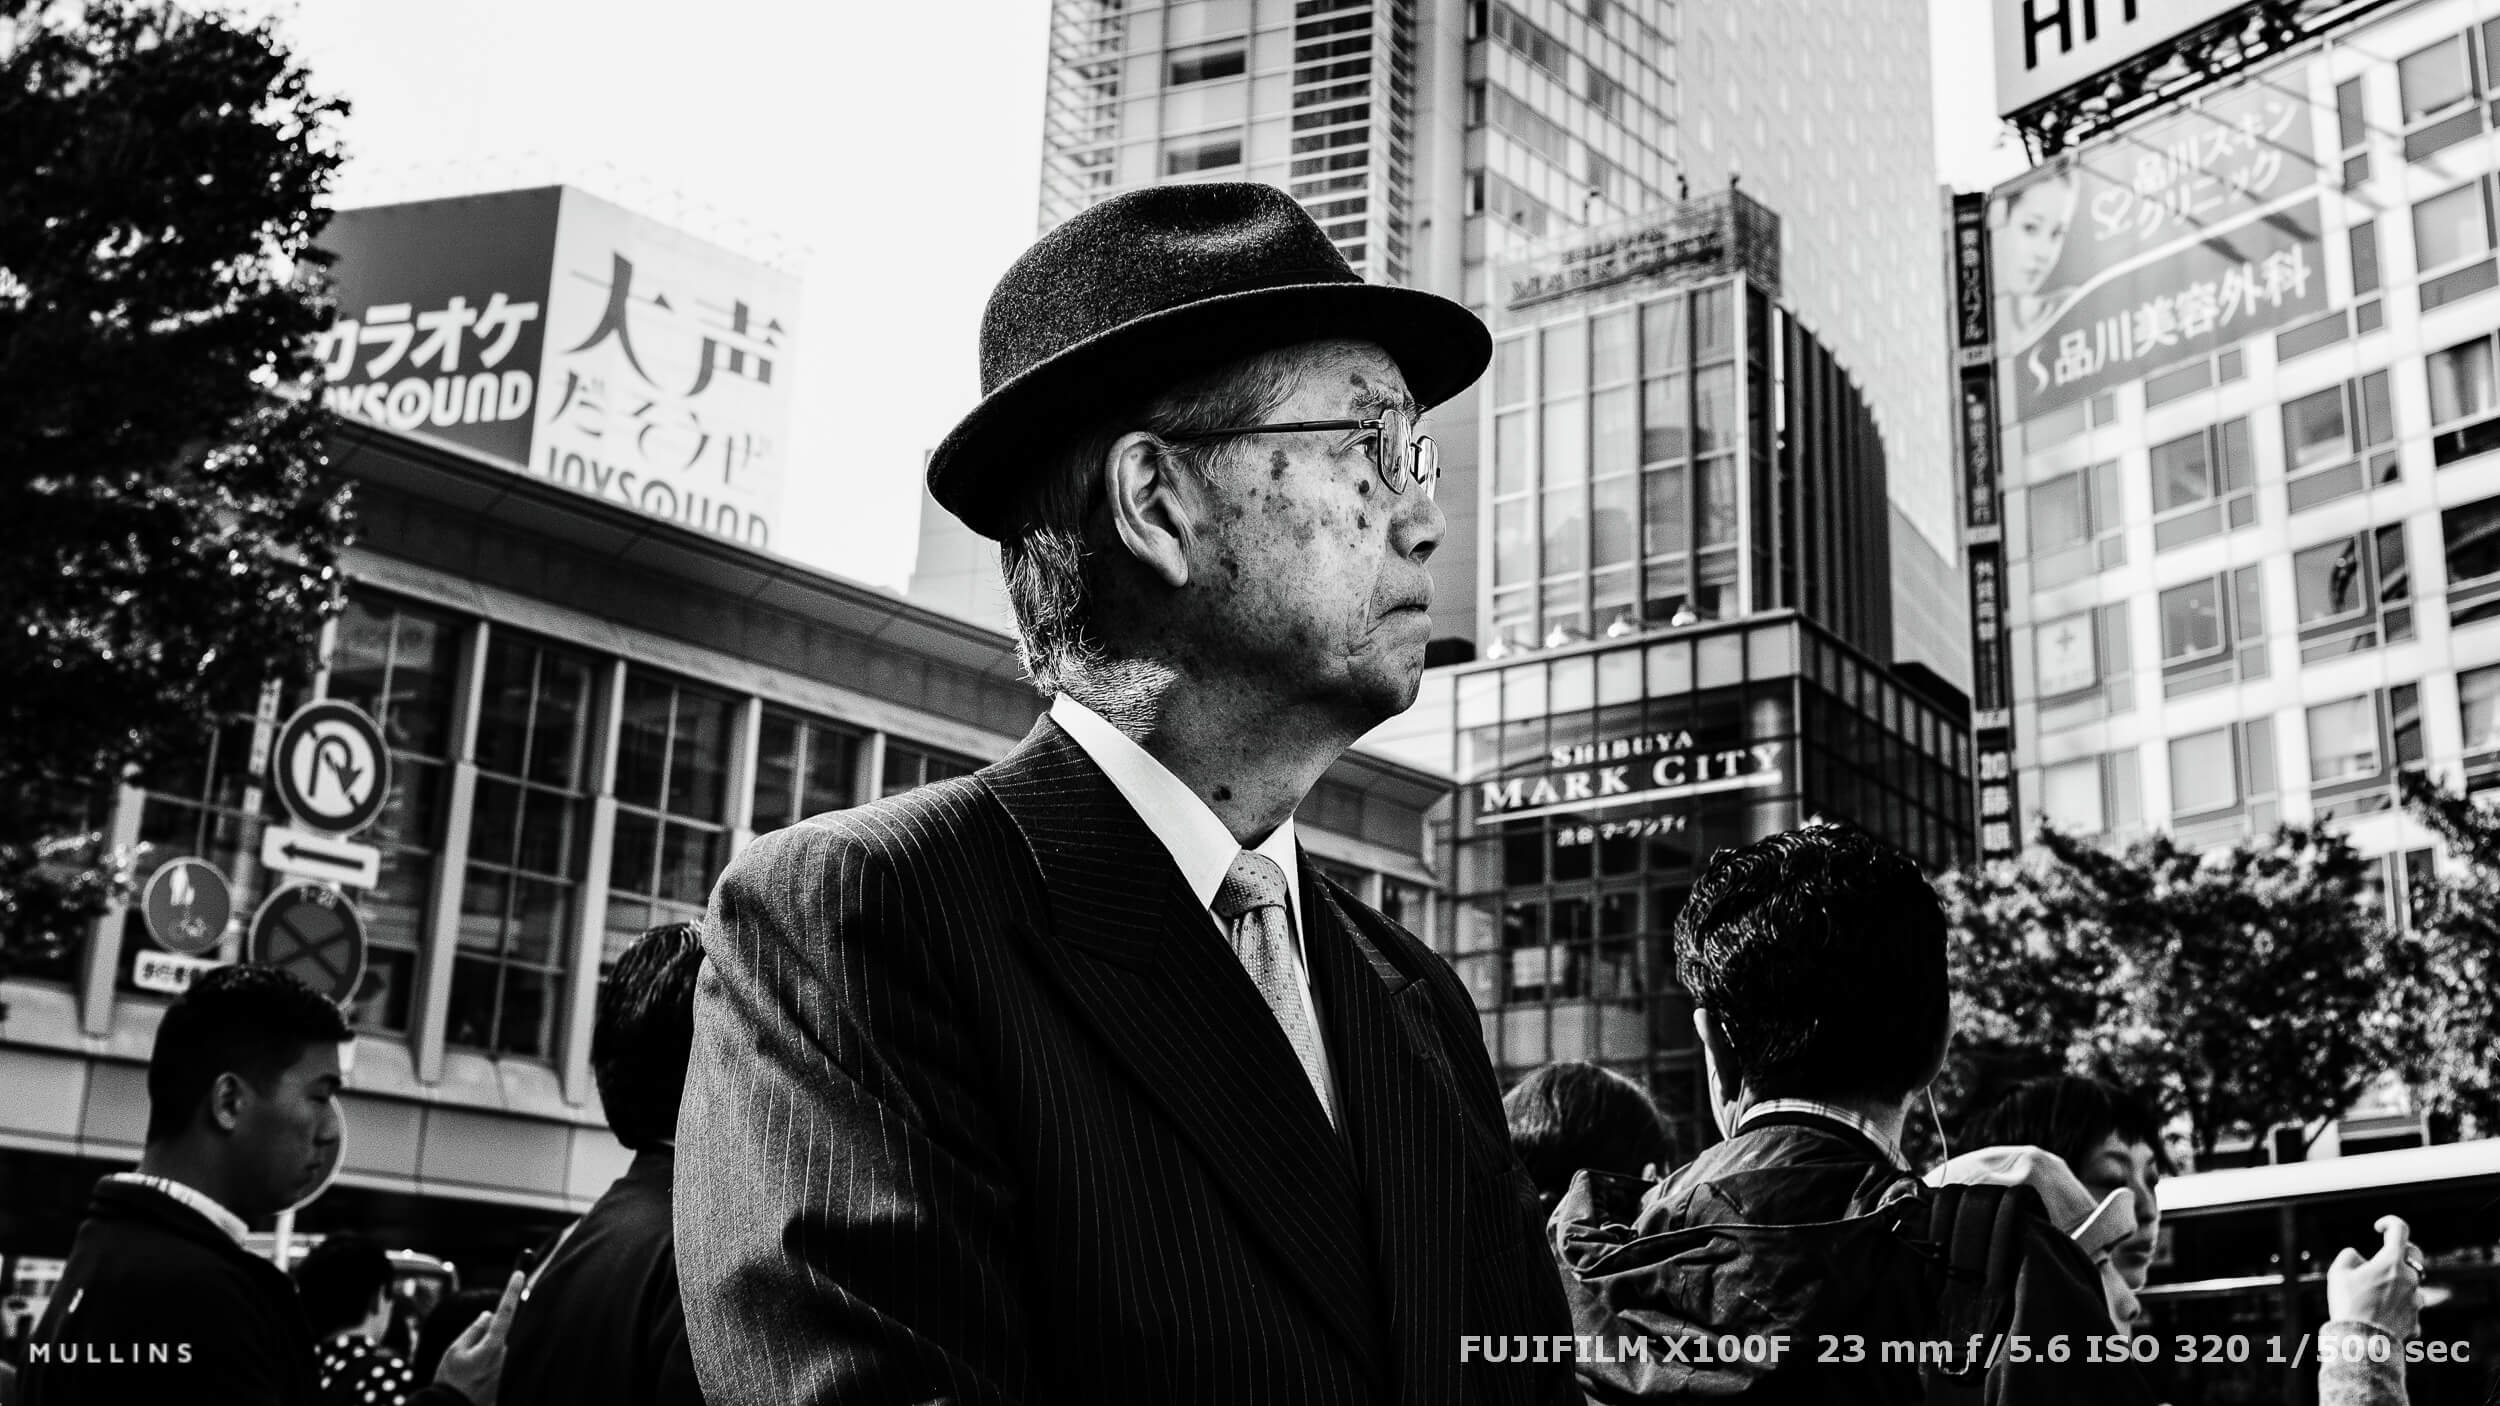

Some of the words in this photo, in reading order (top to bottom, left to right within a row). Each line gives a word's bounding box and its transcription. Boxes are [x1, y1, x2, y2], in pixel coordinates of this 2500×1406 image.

[2023, 0, 2138, 70] HI
[2134, 102, 2298, 194] 品川スキン
[2137, 150, 2283, 239] クリニック
[312, 292, 540, 383] カラオケ
[560, 249, 788, 398] 大声
[2054, 246, 2312, 387] 品川美容外科
[1481, 765, 1630, 812] MARK
[1652, 741, 1783, 787] CITY
[1551, 730, 1693, 768] SHIBUYA
